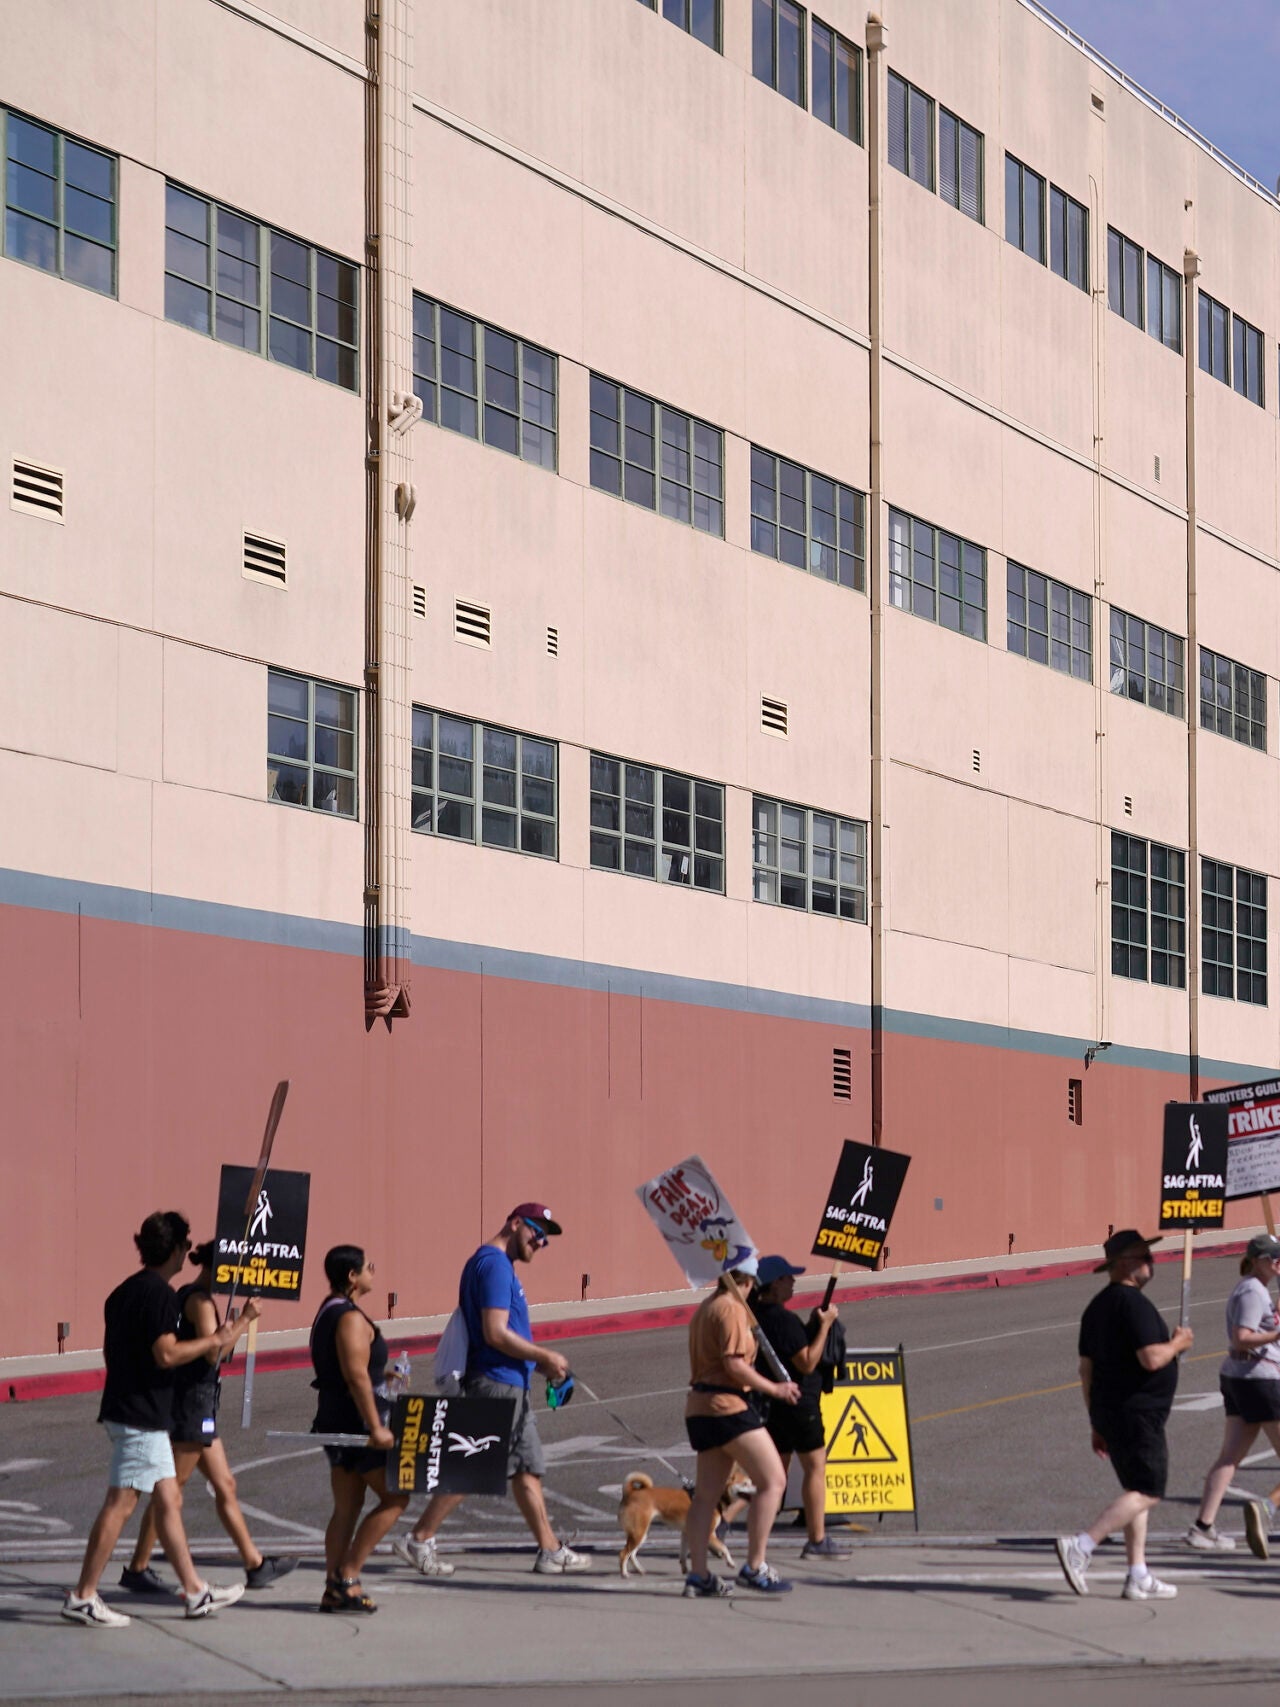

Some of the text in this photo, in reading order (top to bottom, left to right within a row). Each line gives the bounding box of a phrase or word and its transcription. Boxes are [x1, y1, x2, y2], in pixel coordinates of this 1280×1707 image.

[1207, 1087, 1253, 1104] WRITERS
[1185, 1190, 1199, 1200] ON
[1162, 1199, 1223, 1219] STRIKE!
[843, 1224, 857, 1235] ON
[817, 1228, 881, 1258] STRIKE!
[250, 1257, 268, 1268] ON
[216, 1264, 300, 1289] STRIKE!
[834, 1361, 895, 1381] TION
[398, 1397, 425, 1491] STRIKE!
[418, 1433, 428, 1453] ON
[826, 1472, 905, 1489] EDESTRIAN
[833, 1490, 894, 1505] TRAFFIC
